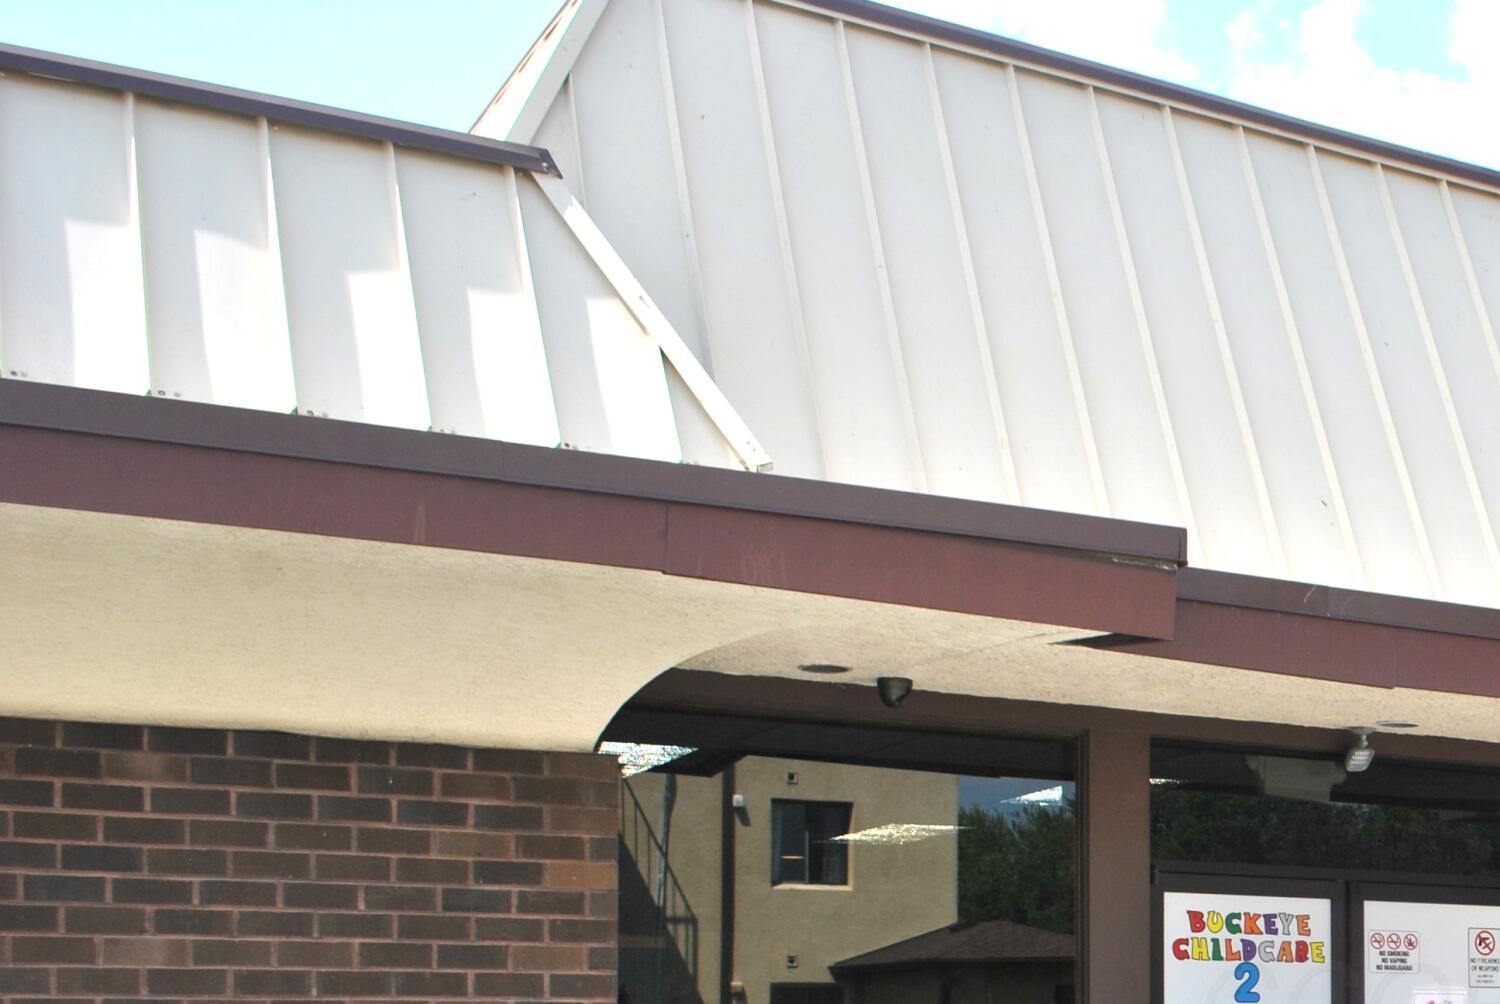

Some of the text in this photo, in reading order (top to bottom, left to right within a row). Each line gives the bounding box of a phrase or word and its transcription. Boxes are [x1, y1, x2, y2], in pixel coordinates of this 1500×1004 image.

[1187, 910, 1311, 936] BUCKEYE
[1172, 937, 1325, 963] CHILDCARE
[1234, 962, 1260, 1003] 2
